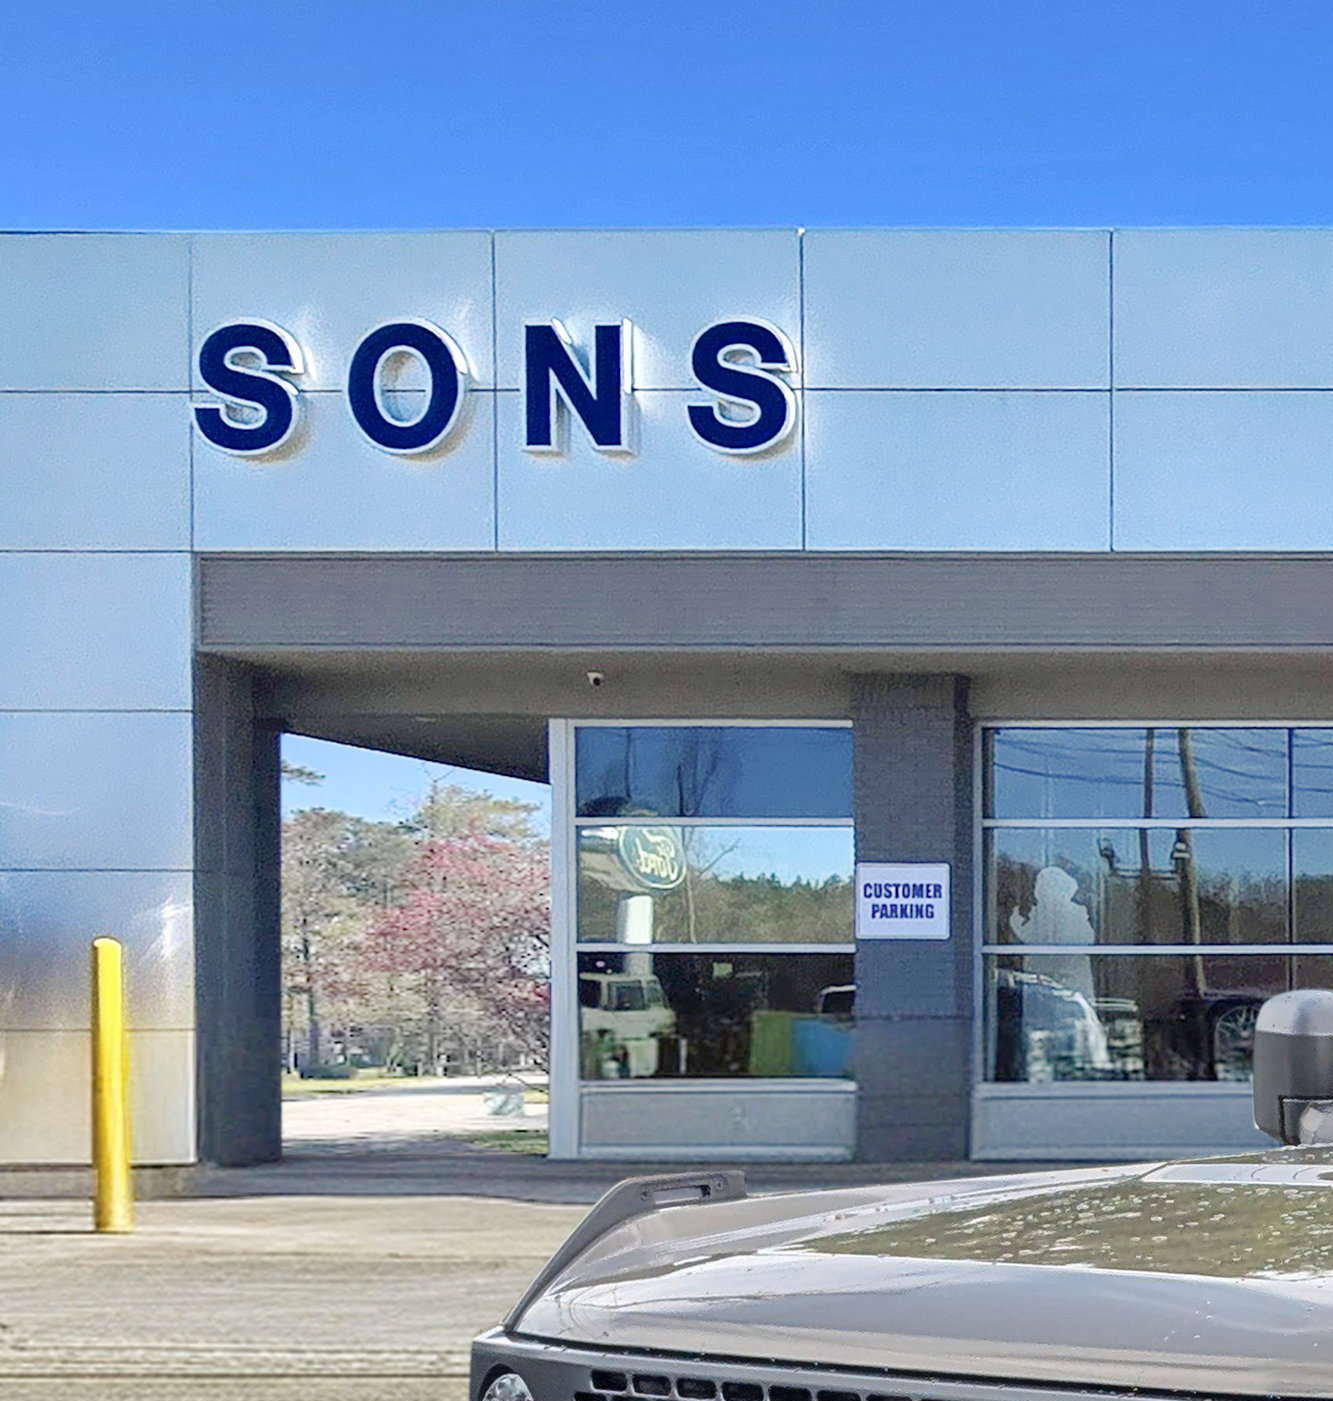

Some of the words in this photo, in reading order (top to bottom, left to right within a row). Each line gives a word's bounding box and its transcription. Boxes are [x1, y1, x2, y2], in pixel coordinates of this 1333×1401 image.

[193, 317, 801, 457] SONS
[863, 882, 943, 899] CUSTOMER
[871, 904, 935, 919] PARKING
